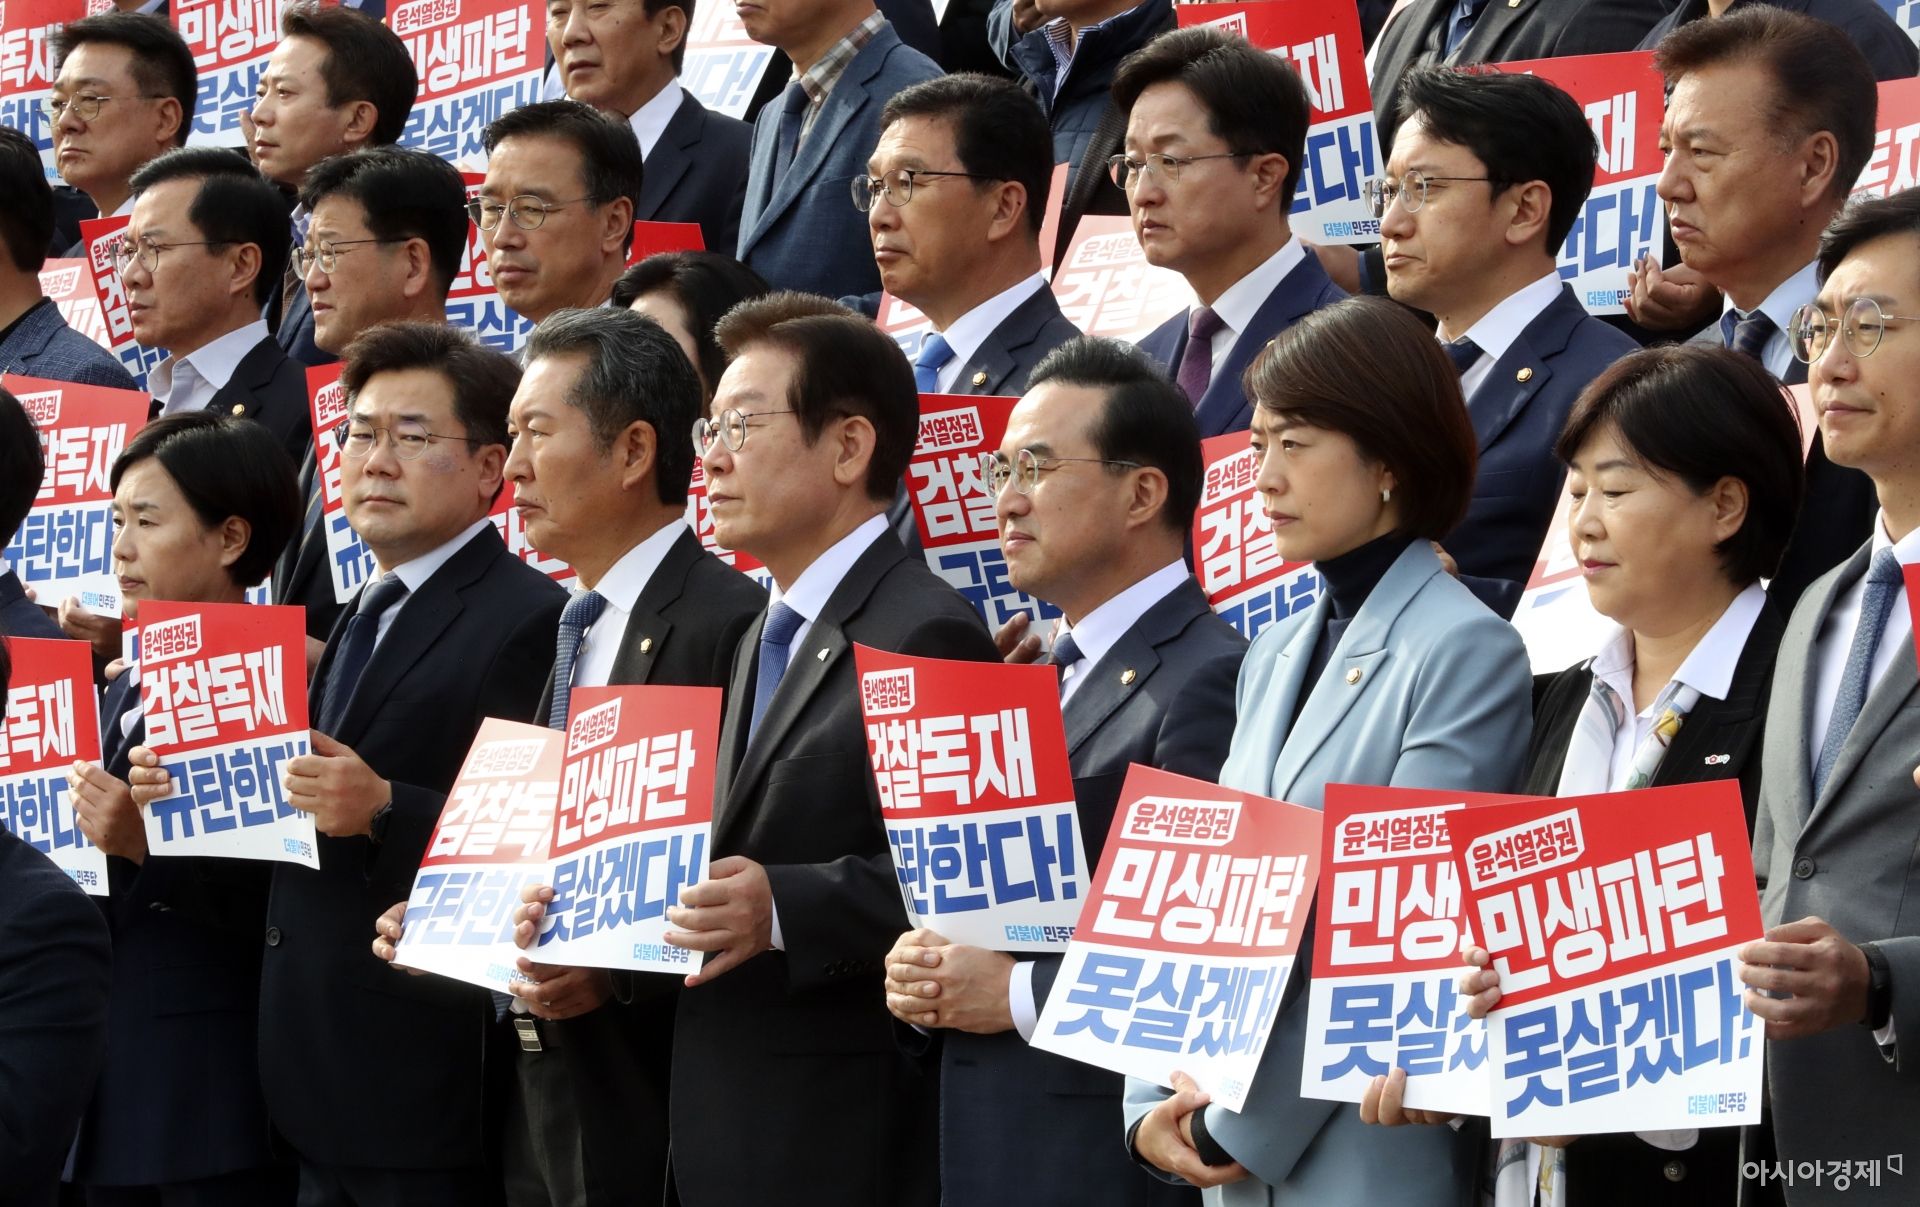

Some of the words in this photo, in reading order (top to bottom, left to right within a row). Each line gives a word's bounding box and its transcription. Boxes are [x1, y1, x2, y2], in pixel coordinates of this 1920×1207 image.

[178, 0, 281, 68] 민생파
[917, 412, 979, 451] 석열정권
[143, 619, 198, 661] 윤석열정권
[142, 644, 288, 749] 검찰독재
[863, 674, 911, 711] 윤석열정권
[571, 704, 618, 751] 윤석열정권
[867, 707, 1037, 810] 검찰독재
[427, 780, 561, 860] 검찰독
[556, 730, 696, 849] 민생파탄
[1128, 802, 1235, 841] 윤석열정권
[1471, 817, 1579, 880] 윤석열정권
[1092, 847, 1309, 947] 민생파탄
[1477, 831, 1727, 996] 민생파탄
[632, 943, 691, 965] 더불어민주당
[1053, 951, 1289, 1058] 못살겠다!
[1687, 1092, 1747, 1116] 더불어민주당
